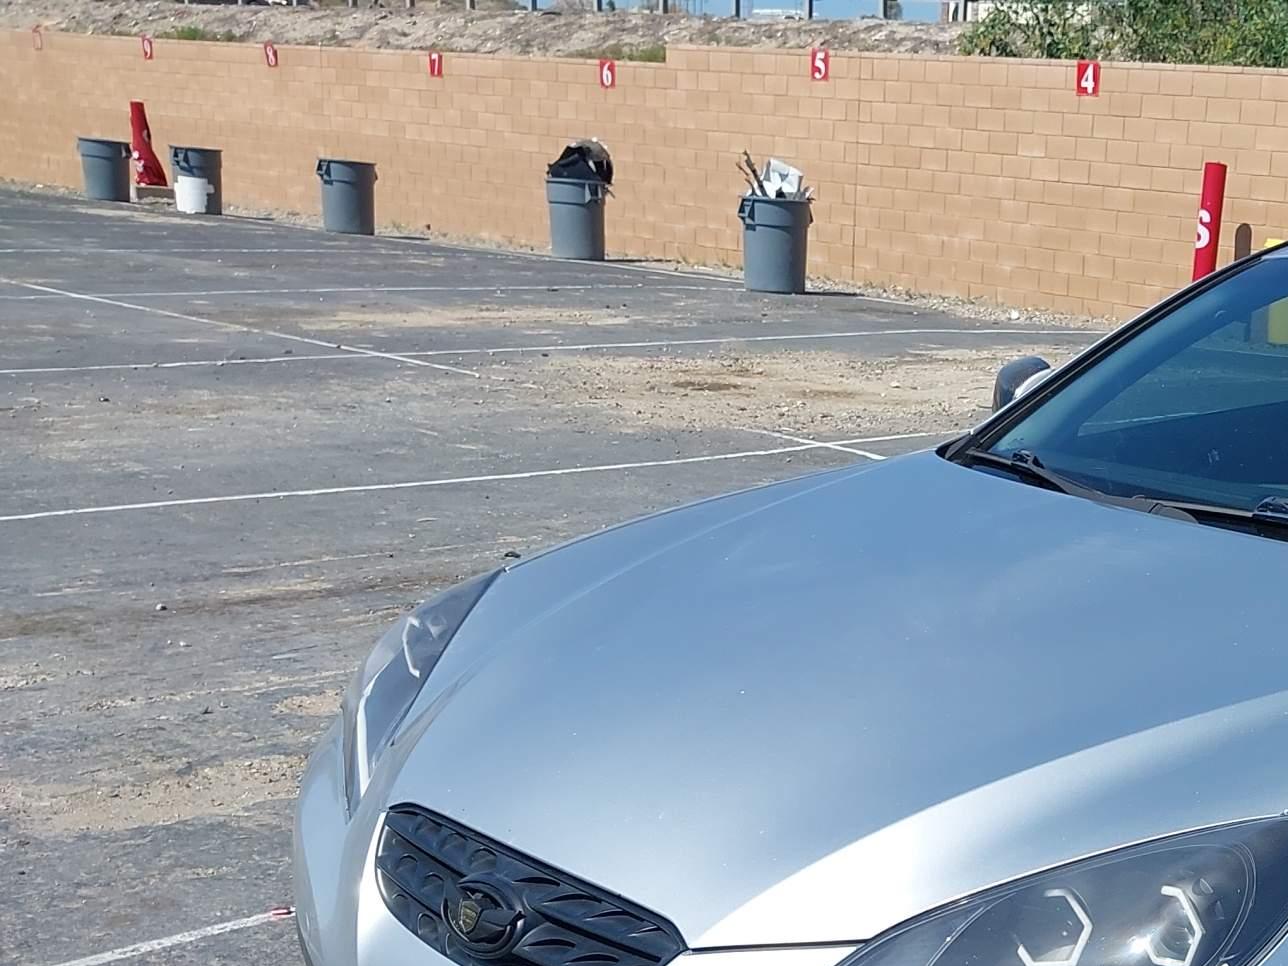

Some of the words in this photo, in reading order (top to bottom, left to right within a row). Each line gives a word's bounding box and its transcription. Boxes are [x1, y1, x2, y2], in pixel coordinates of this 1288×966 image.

[266, 45, 276, 66] 8
[431, 53, 440, 76] 7
[814, 51, 826, 79] 5
[602, 61, 613, 87] 6
[1080, 64, 1095, 94] 4
